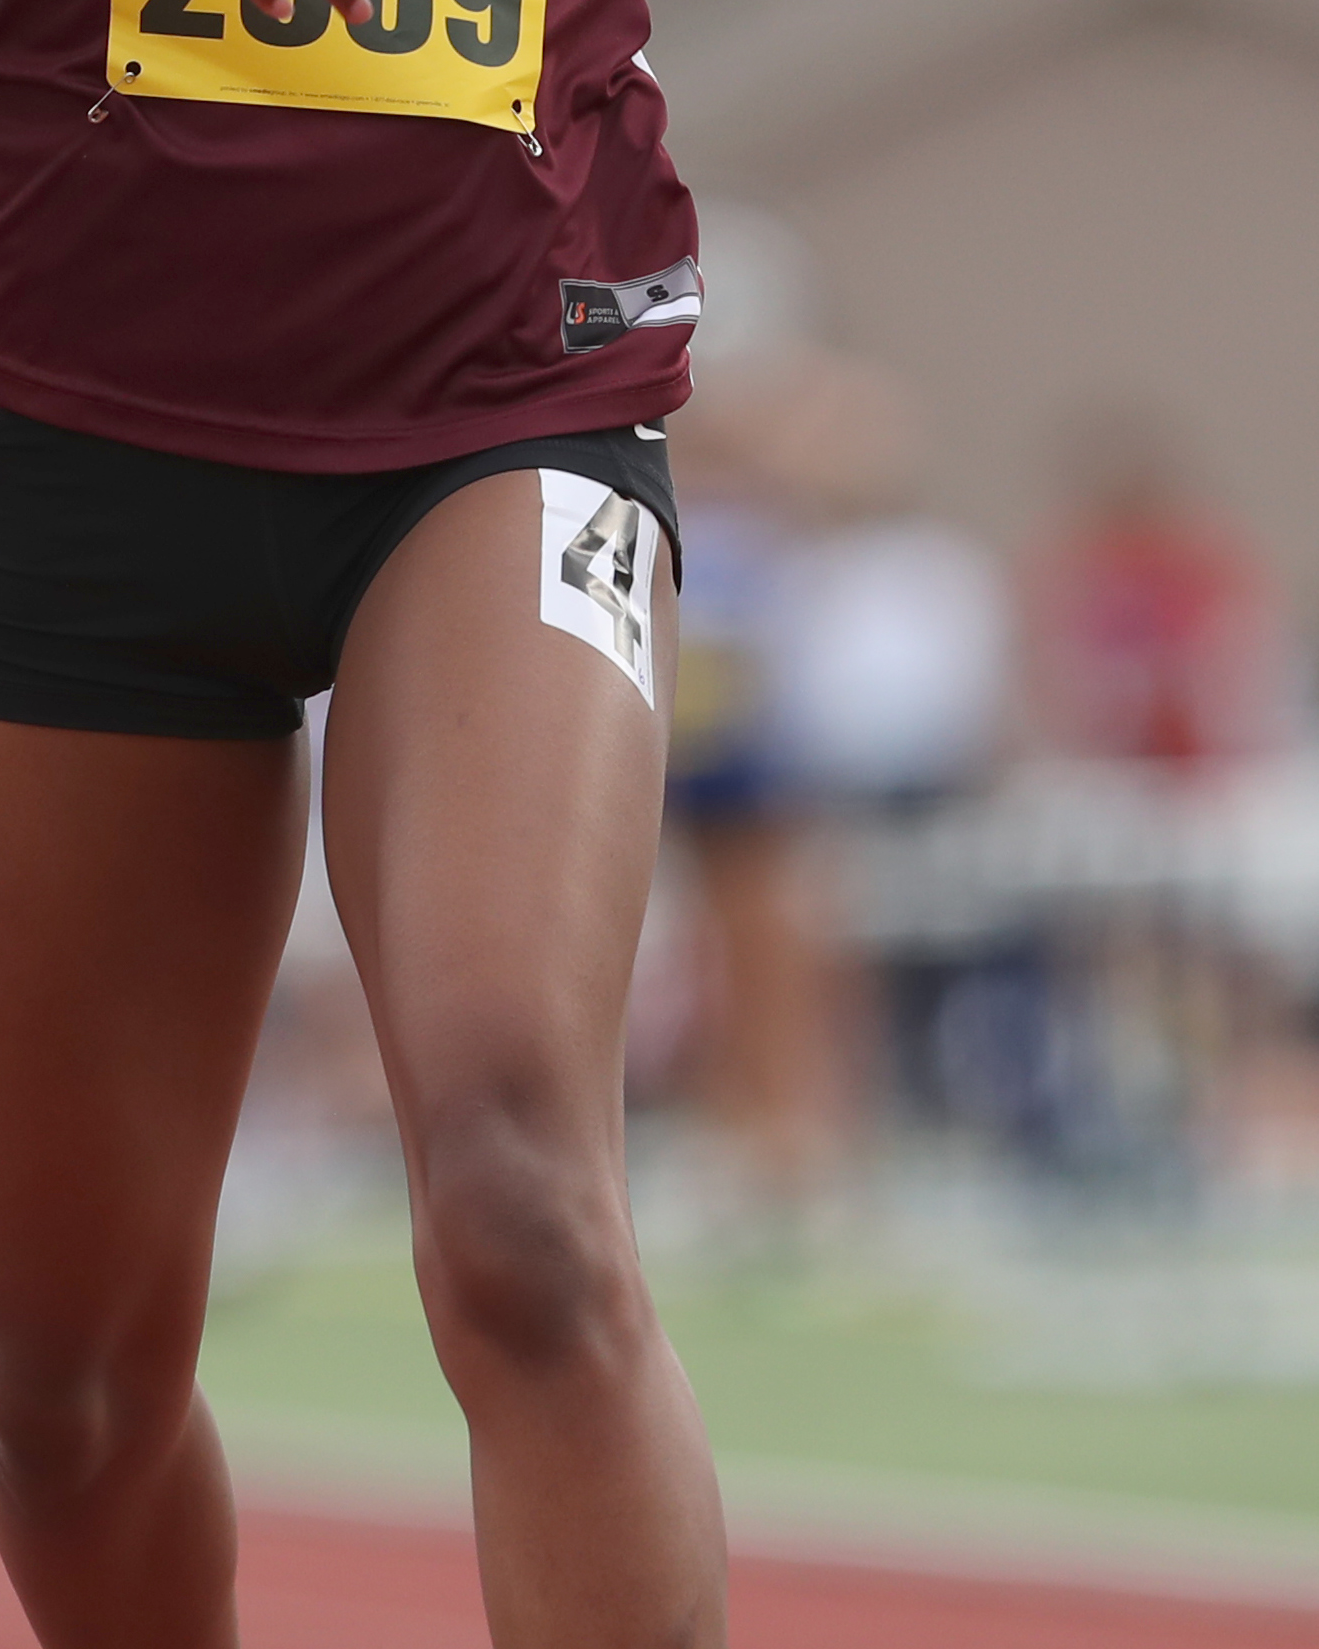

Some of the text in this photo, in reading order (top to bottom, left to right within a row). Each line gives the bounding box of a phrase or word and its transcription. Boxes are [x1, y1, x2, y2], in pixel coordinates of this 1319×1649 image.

[588, 307, 613, 317] SPORTS
[586, 315, 621, 324] APPAREL
[561, 490, 643, 671] 4
